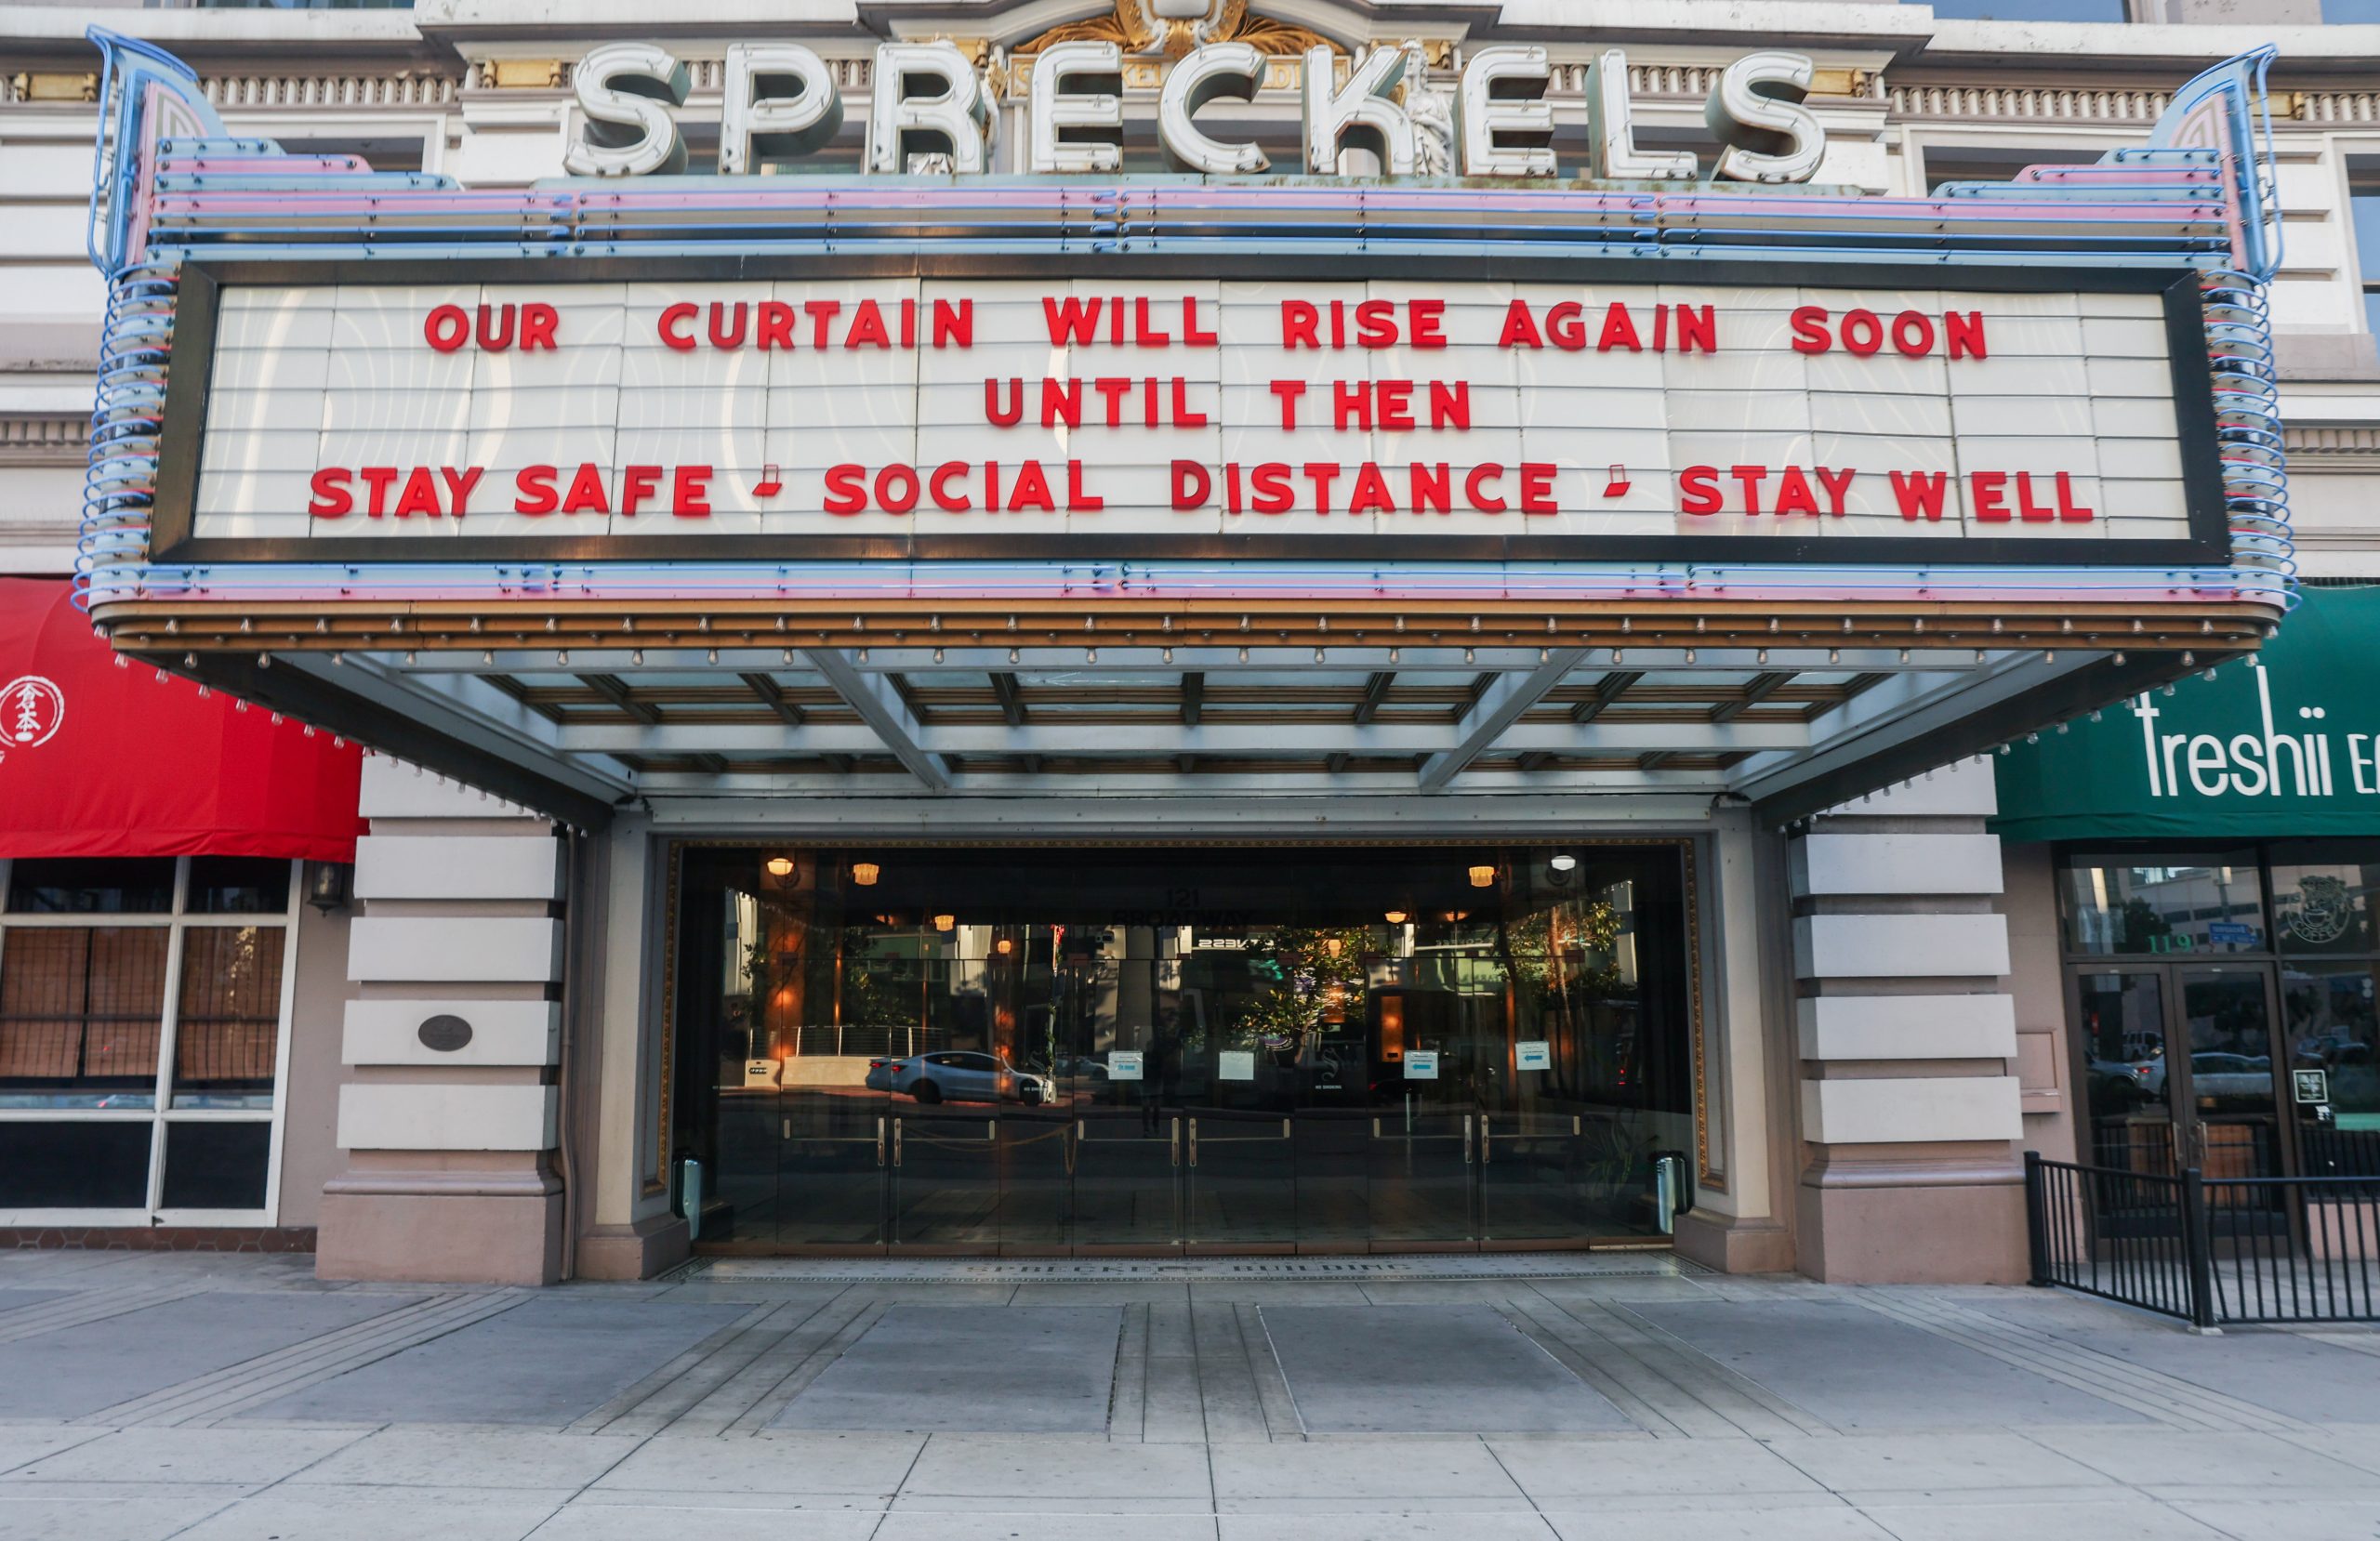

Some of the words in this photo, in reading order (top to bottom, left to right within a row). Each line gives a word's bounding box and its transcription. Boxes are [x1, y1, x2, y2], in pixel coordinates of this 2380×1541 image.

[562, 41, 1825, 183] SPRECKELS
[424, 301, 561, 356] OUR
[658, 296, 974, 354] CURTAIN
[1042, 296, 1219, 350] WILL
[1281, 298, 1448, 353] RISE
[1498, 298, 1718, 356] AGAIN
[1790, 305, 1988, 362] SOON
[985, 375, 1208, 432] UNTIL
[1269, 378, 1472, 433] THEN
[309, 465, 484, 521] STAY
[513, 461, 714, 520] SAFE
[823, 458, 1105, 519] SOCIAL
[1171, 459, 1559, 517] DISTANCE
[1679, 464, 1856, 520] STAY
[1889, 469, 2095, 525] WELL
[2148, 934, 2192, 954] 119
